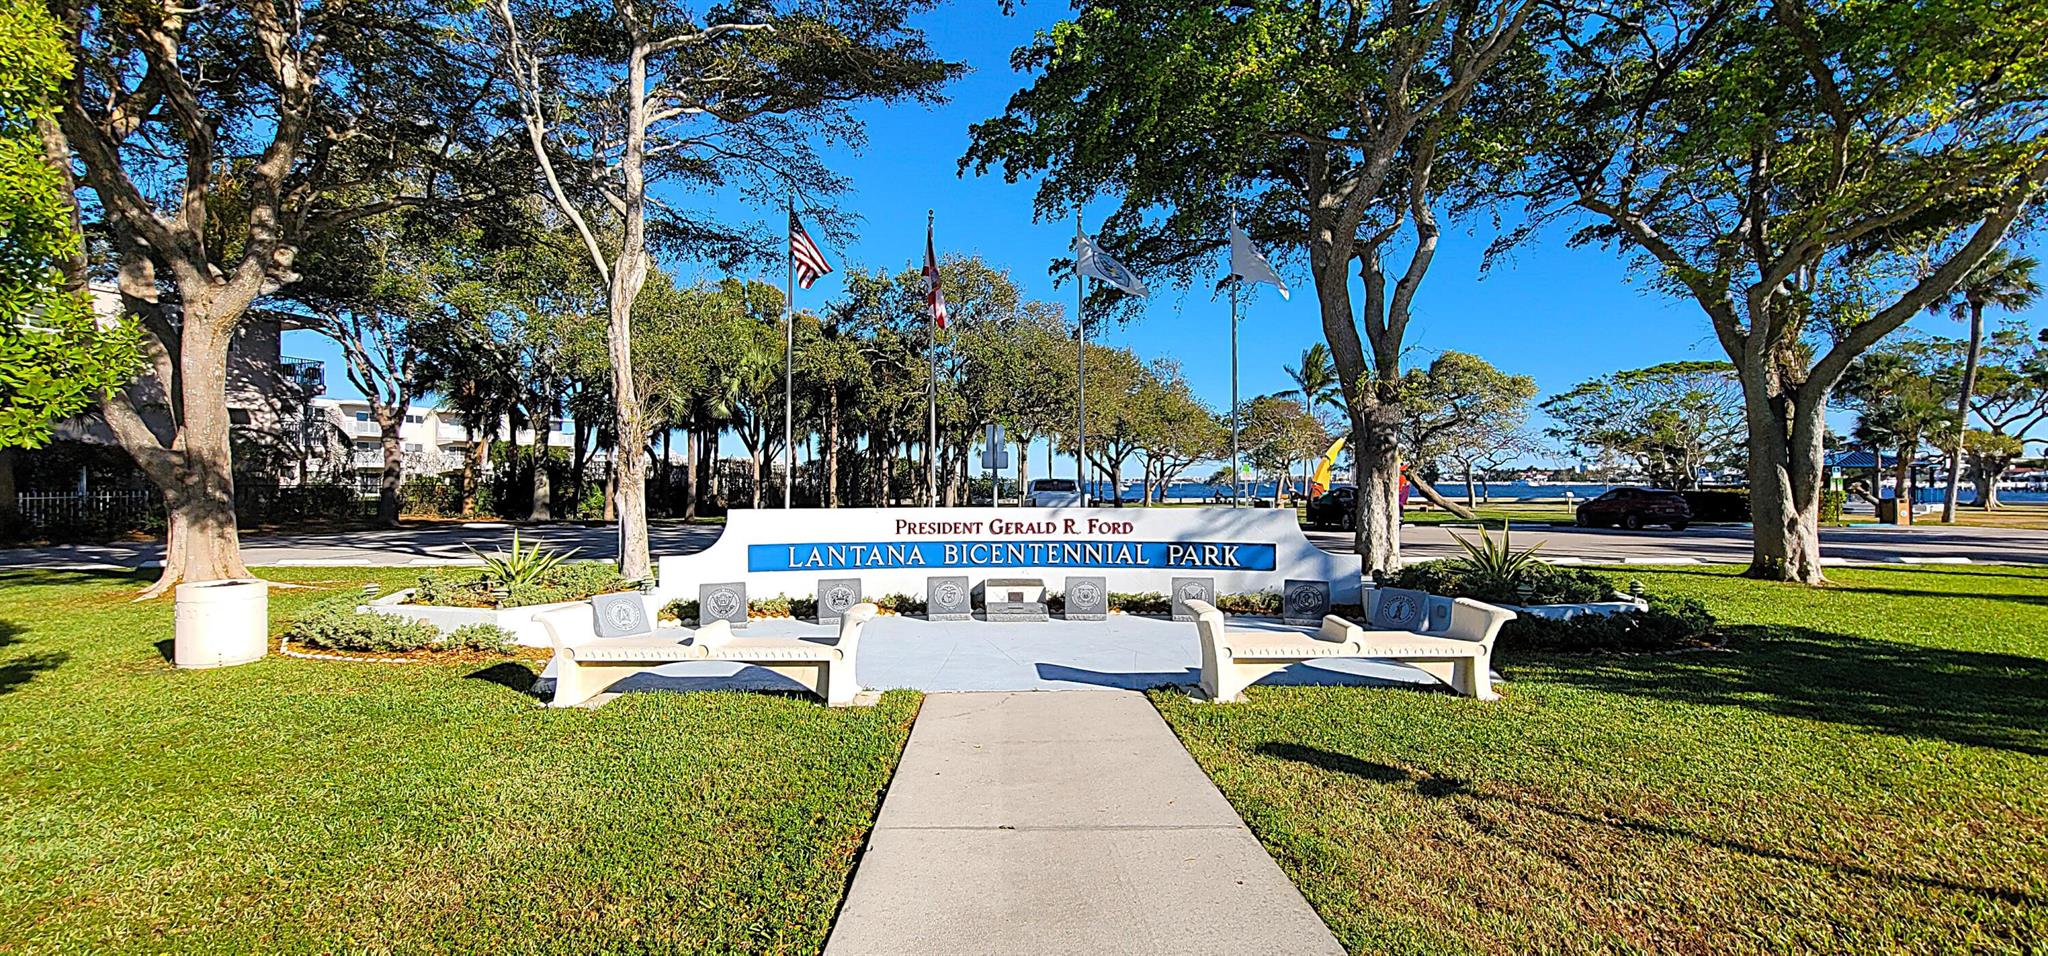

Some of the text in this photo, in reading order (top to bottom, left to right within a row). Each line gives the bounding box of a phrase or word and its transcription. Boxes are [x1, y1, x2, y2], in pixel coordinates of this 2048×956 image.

[1063, 518, 1081, 535] R.
[788, 543, 1240, 568] LANTANA BICENTENNIAL PARK
